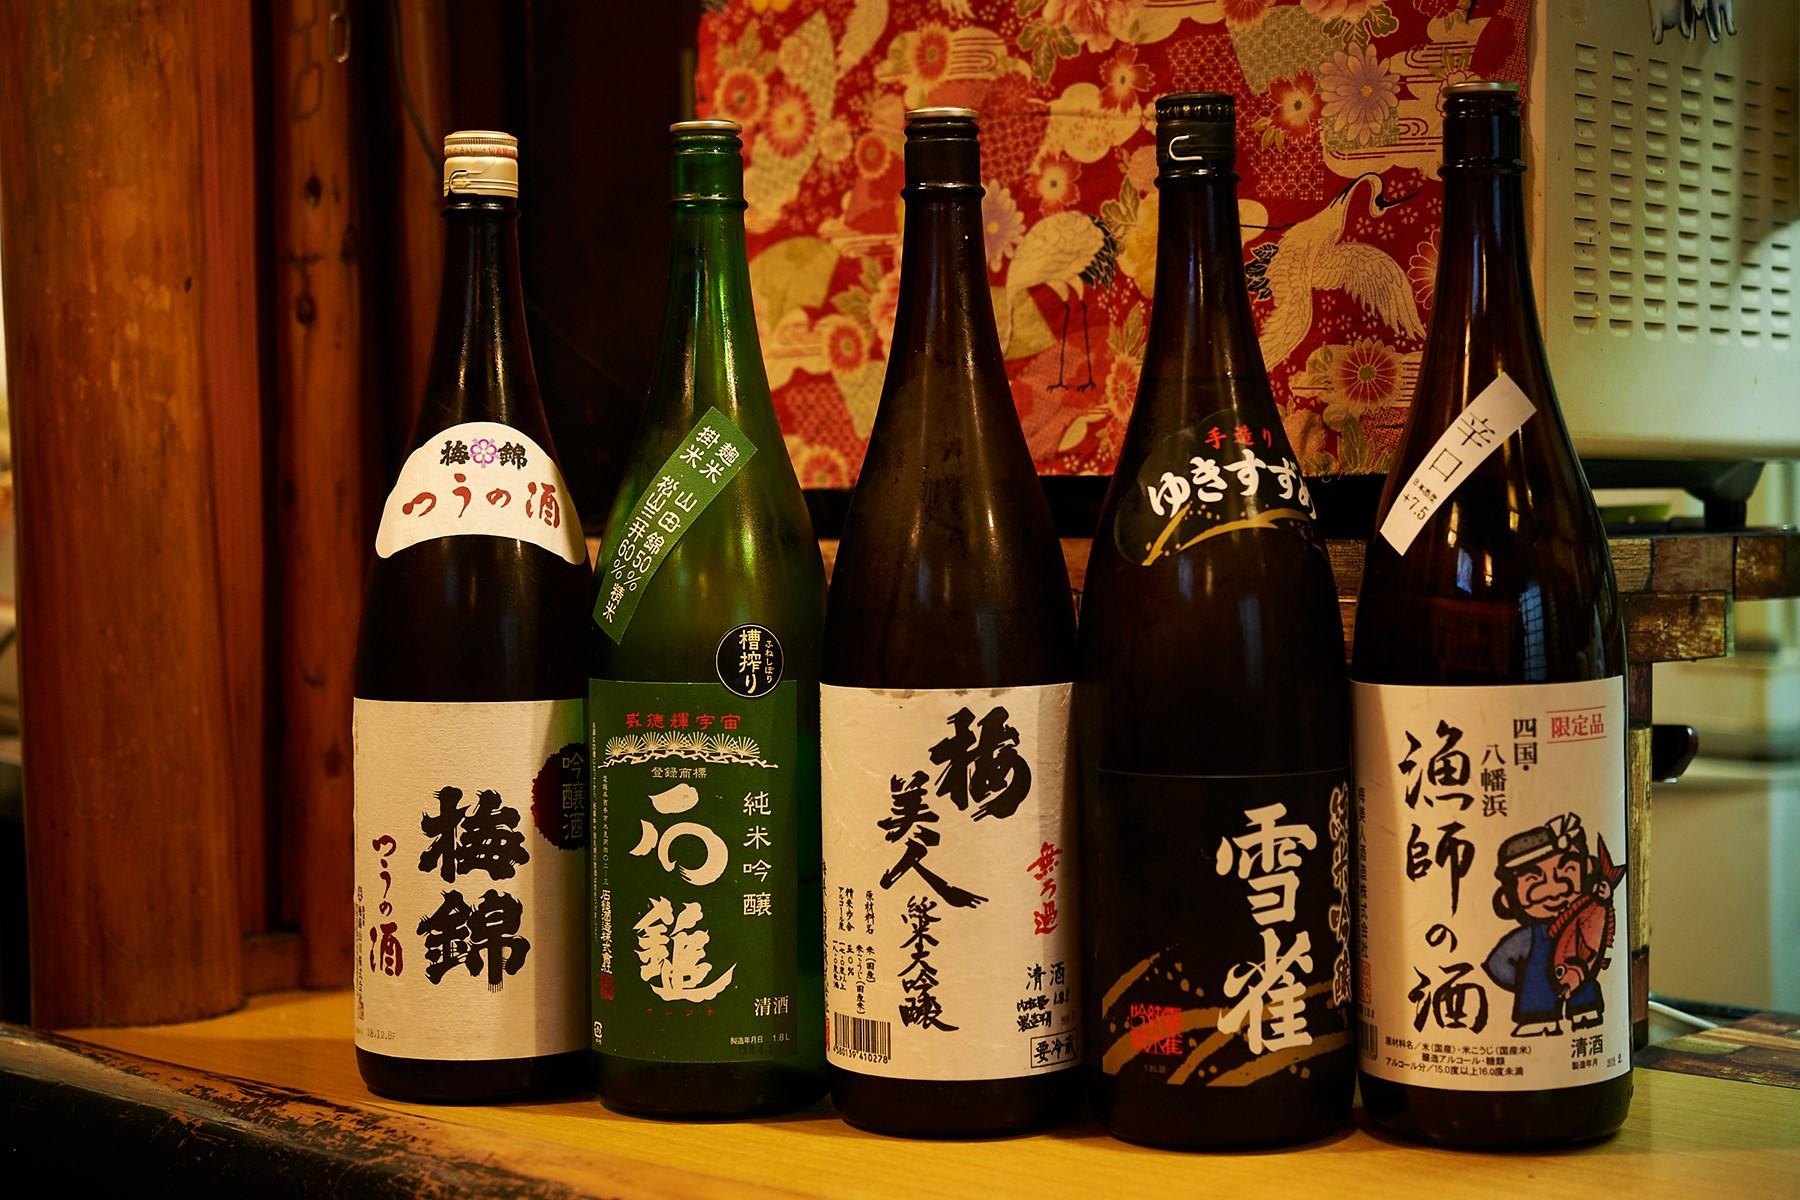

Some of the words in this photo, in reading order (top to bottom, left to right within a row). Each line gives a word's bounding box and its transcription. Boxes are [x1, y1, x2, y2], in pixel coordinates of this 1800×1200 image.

[439, 440, 528, 470] 梅錦
[679, 425, 721, 468] 掛米
[1204, 424, 1272, 450] 手造り
[1428, 411, 1496, 482] 辛口
[402, 473, 561, 529] つうの酒
[738, 628, 762, 694] 槽搾り
[764, 640, 775, 684] ふねしぼり
[1550, 713, 1605, 739] 限定品
[561, 750, 585, 841] 吟醸酒
[650, 767, 708, 780] 登録商標
[1480, 743, 1508, 818] 八幡浜
[742, 791, 773, 918] 純米吟醸
[1398, 719, 1489, 1035] 漁師の酒
[369, 834, 404, 978] つうの酒
[416, 785, 531, 994] 梅錦
[1215, 801, 1318, 1056] 雪雀
[897, 895, 960, 1032] 純米大吟醸
[1025, 961, 1066, 991] 清酒
[754, 994, 789, 1018] 清酒
[1571, 1034, 1604, 1059] 清酒
